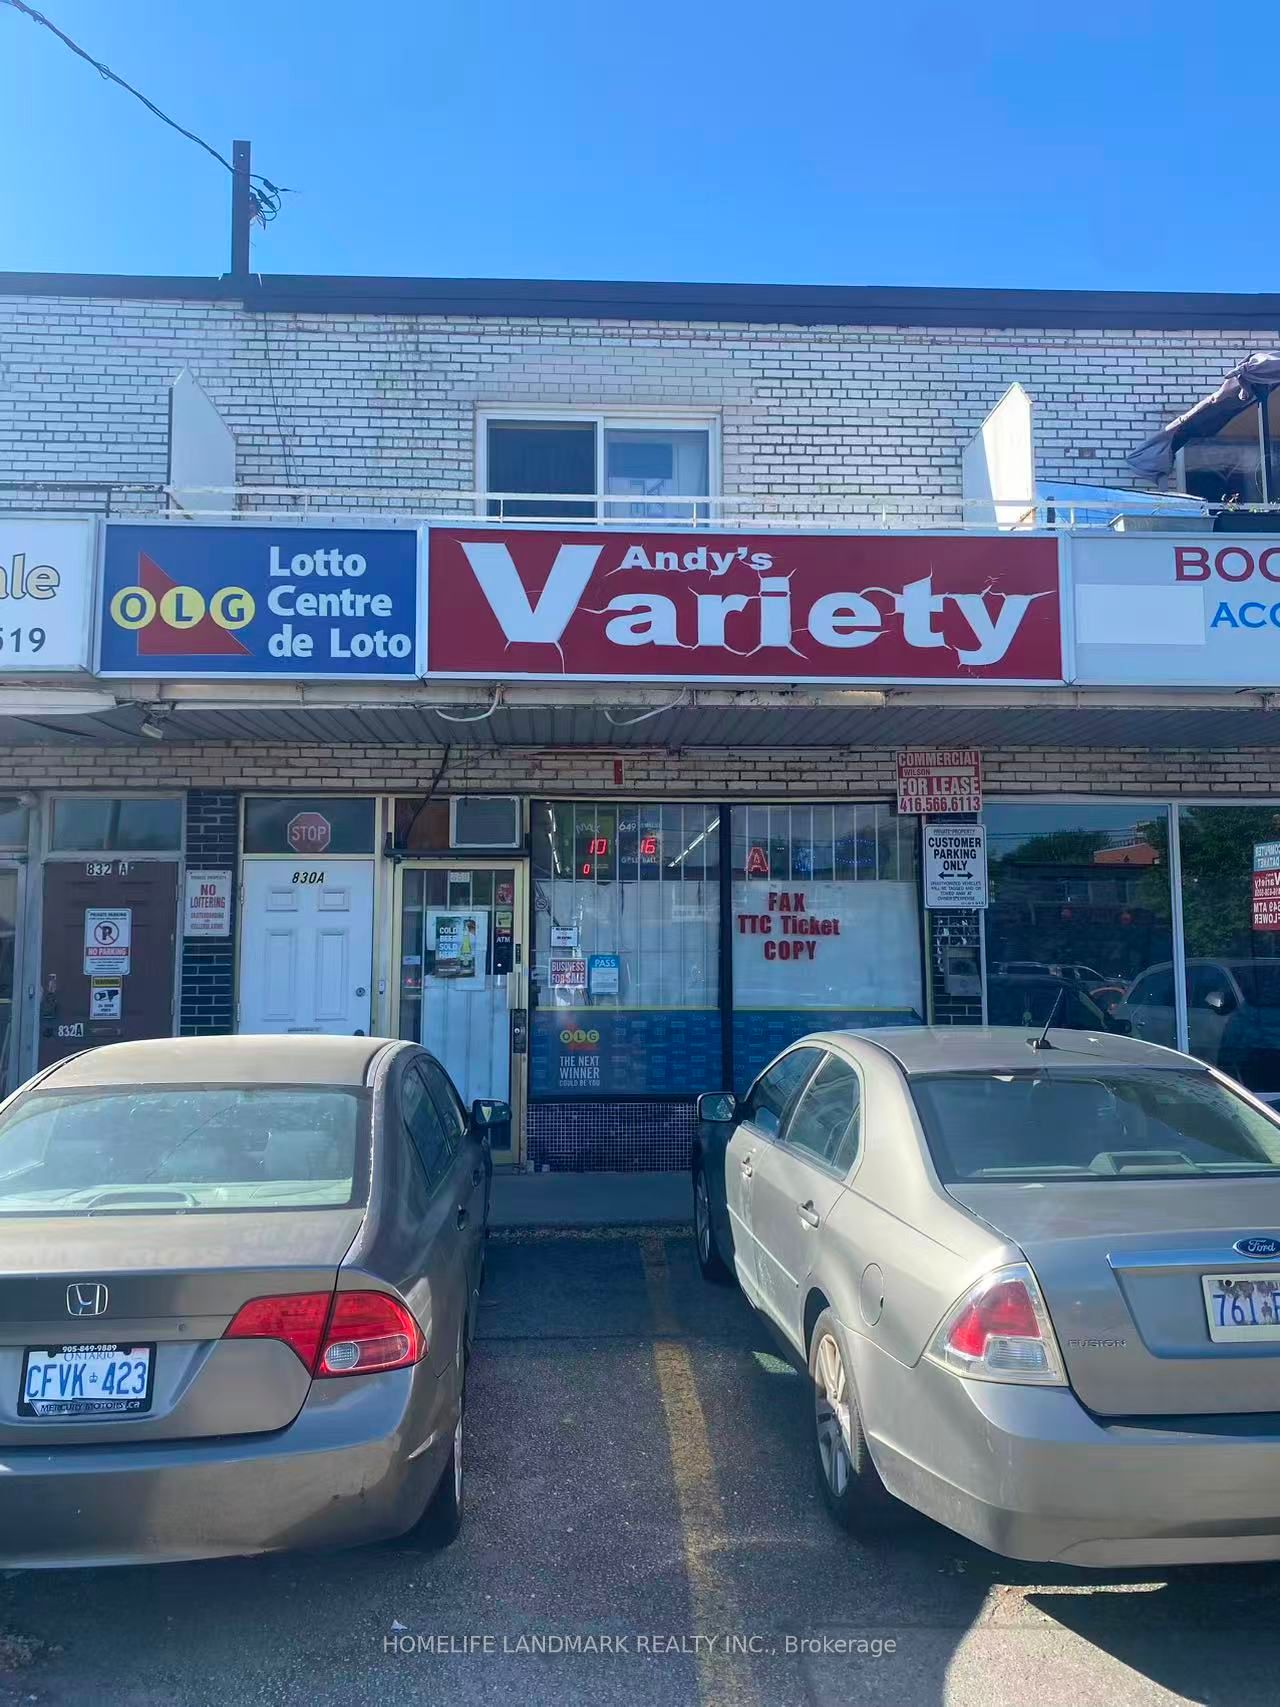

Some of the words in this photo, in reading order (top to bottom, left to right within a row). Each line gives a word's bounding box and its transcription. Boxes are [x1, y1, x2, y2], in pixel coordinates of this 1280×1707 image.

[270, 546, 367, 577] Lotto
[619, 545, 774, 575] Andy's
[267, 585, 393, 617] Centre
[460, 541, 1036, 668] Variety
[116, 590, 250, 626] OLG
[0, 628, 46, 653] 19
[268, 624, 314, 658] de
[330, 627, 412, 658] Loto
[899, 752, 978, 767] COMMERCIAL
[903, 768, 931, 776] WILSON
[900, 778, 928, 795] FOR
[933, 777, 980, 795] LEASE
[900, 796, 980, 812] 416.566.6113
[291, 825, 326, 841] STOP
[619, 821, 637, 832] 649
[589, 838, 608, 855] 10
[640, 838, 656, 854] 16
[928, 837, 982, 848] CUSTOMER
[934, 849, 977, 859] PARKING
[87, 863, 112, 876] 832
[119, 863, 129, 876] A
[943, 860, 968, 871] ONLY
[292, 872, 325, 884] 830A
[201, 884, 217, 896] NO
[191, 897, 226, 908] LOITERING
[768, 892, 806, 912] FAX
[738, 915, 772, 934] TTC
[781, 915, 841, 935] Ticket
[88, 947, 98, 956] NO
[99, 947, 127, 956] PARKING
[439, 943, 458, 951] SOLD
[764, 940, 817, 960] COPY
[551, 961, 585, 972] BUSINESS
[594, 959, 616, 967] PASS
[551, 972, 564, 984] FOR
[565, 972, 585, 984] SALE
[58, 1023, 84, 1037] 832A
[561, 1031, 598, 1042] OLG
[560, 1056, 576, 1066] THE
[578, 1056, 600, 1067] NEXT
[560, 1067, 600, 1079] WINNER
[1247, 1239, 1276, 1252] Ford
[1068, 1339, 1127, 1347] FUSION
[64, 1352, 115, 1362] ONTARIO
[27, 1363, 87, 1397] CFVK
[101, 1361, 147, 1395] 423
